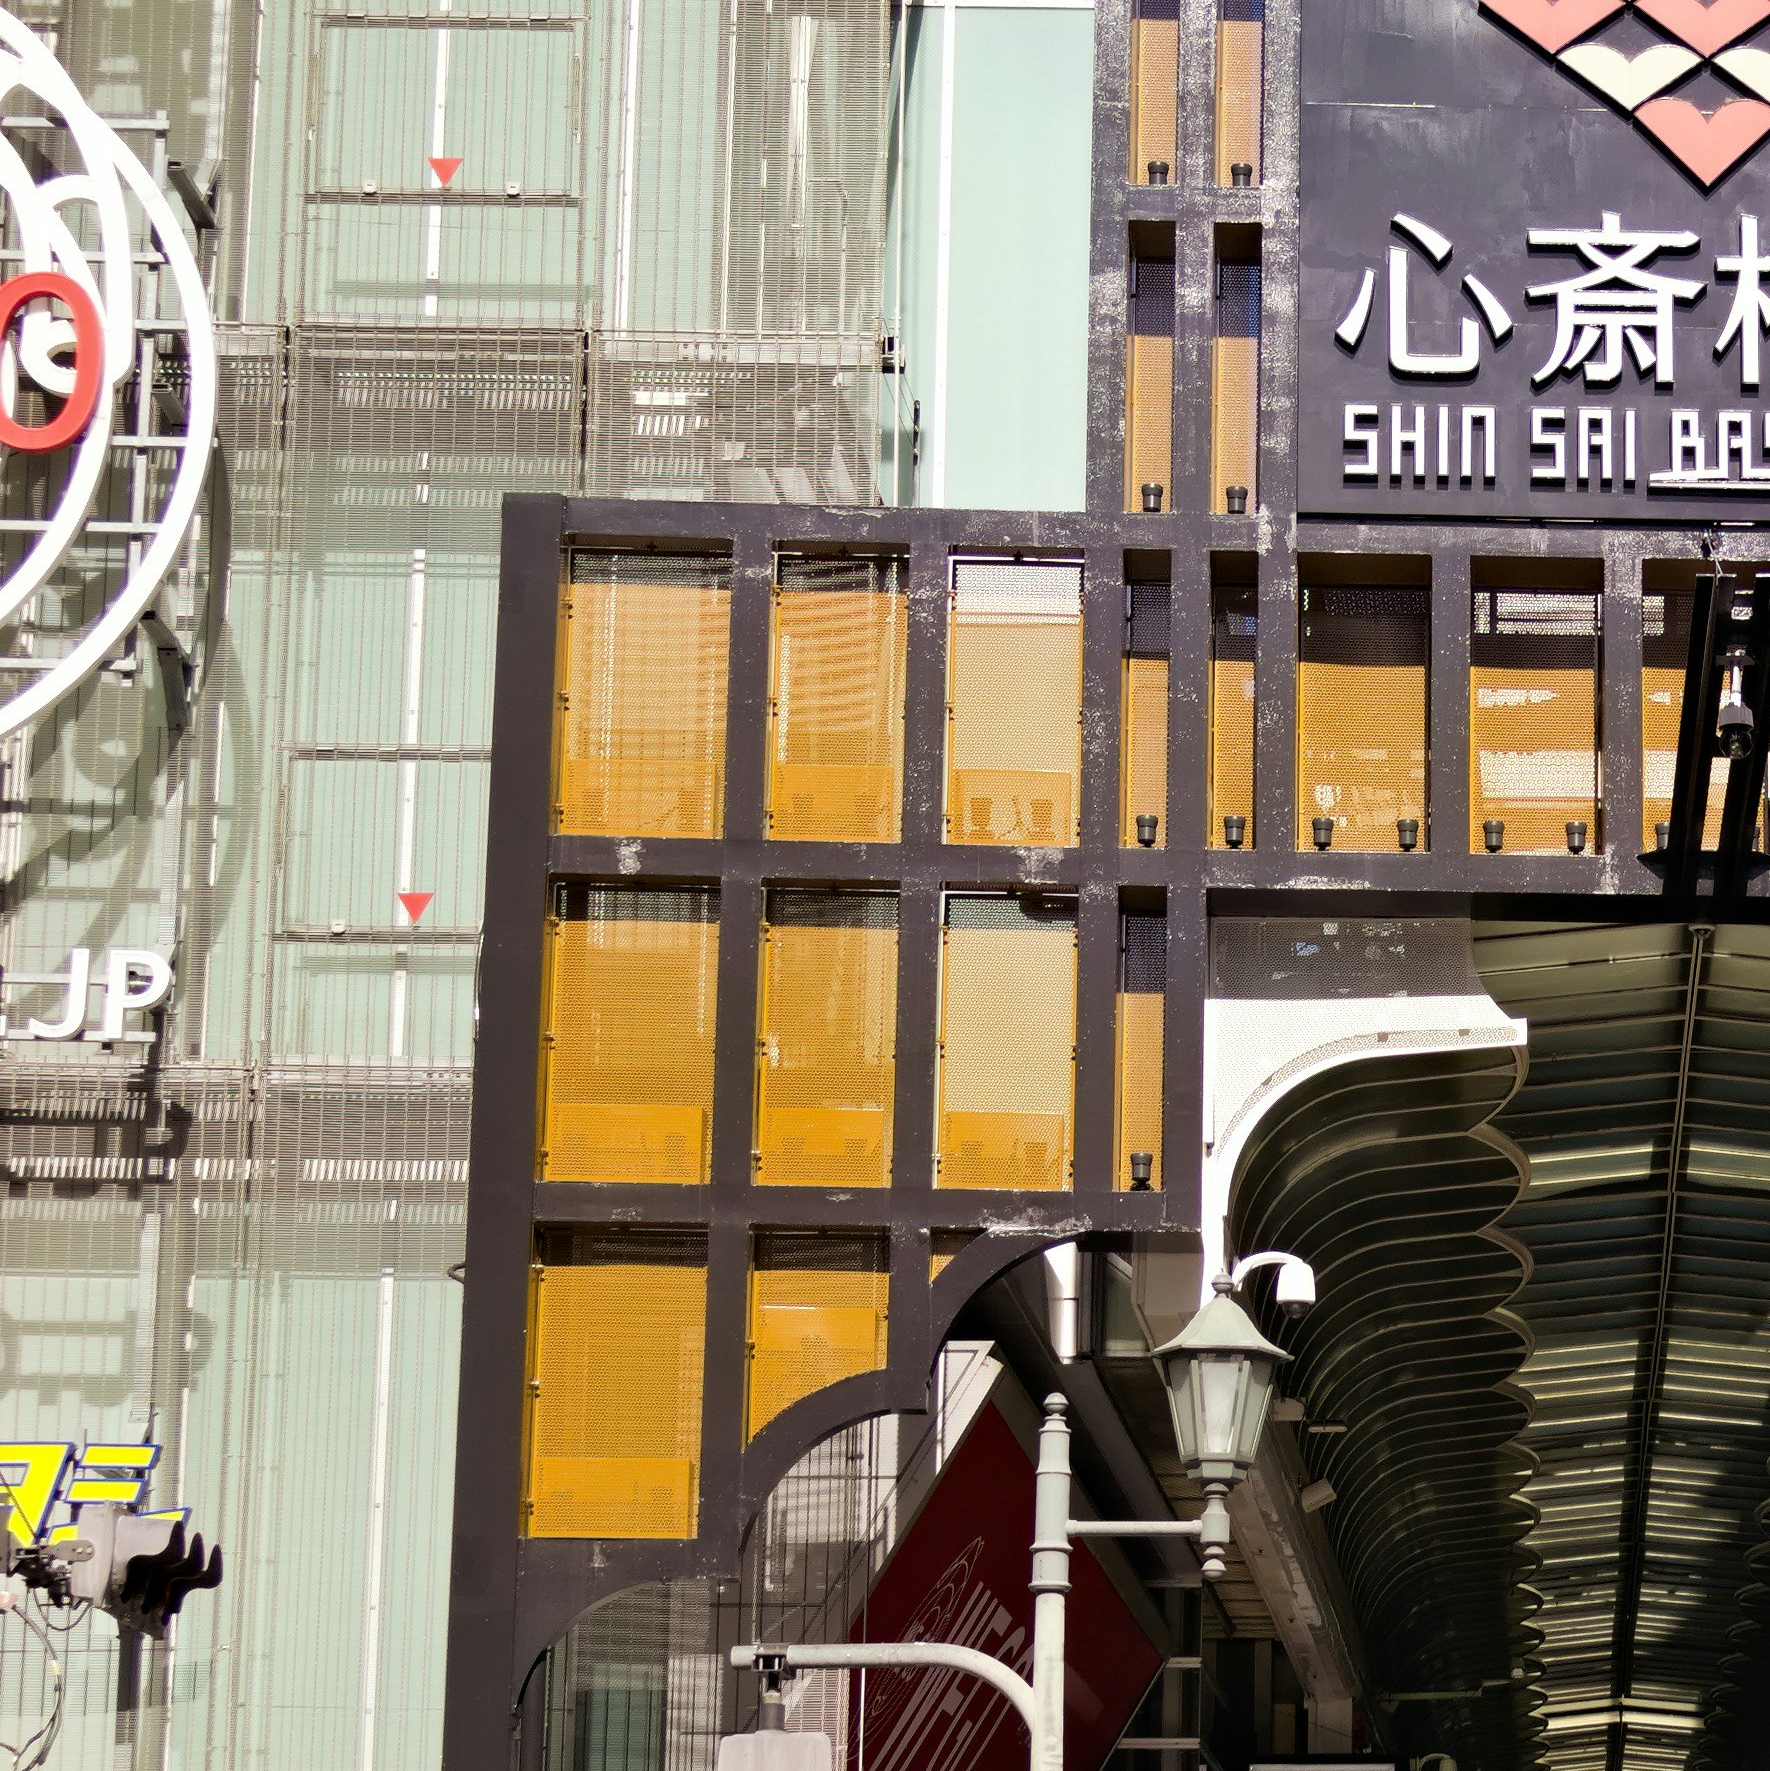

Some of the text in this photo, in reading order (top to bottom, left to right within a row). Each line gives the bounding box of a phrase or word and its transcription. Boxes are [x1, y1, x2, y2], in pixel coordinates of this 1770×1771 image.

[1342, 402, 1498, 485] SHIN
[1531, 406, 1640, 490] SAI
[28, 947, 175, 1041] JP
